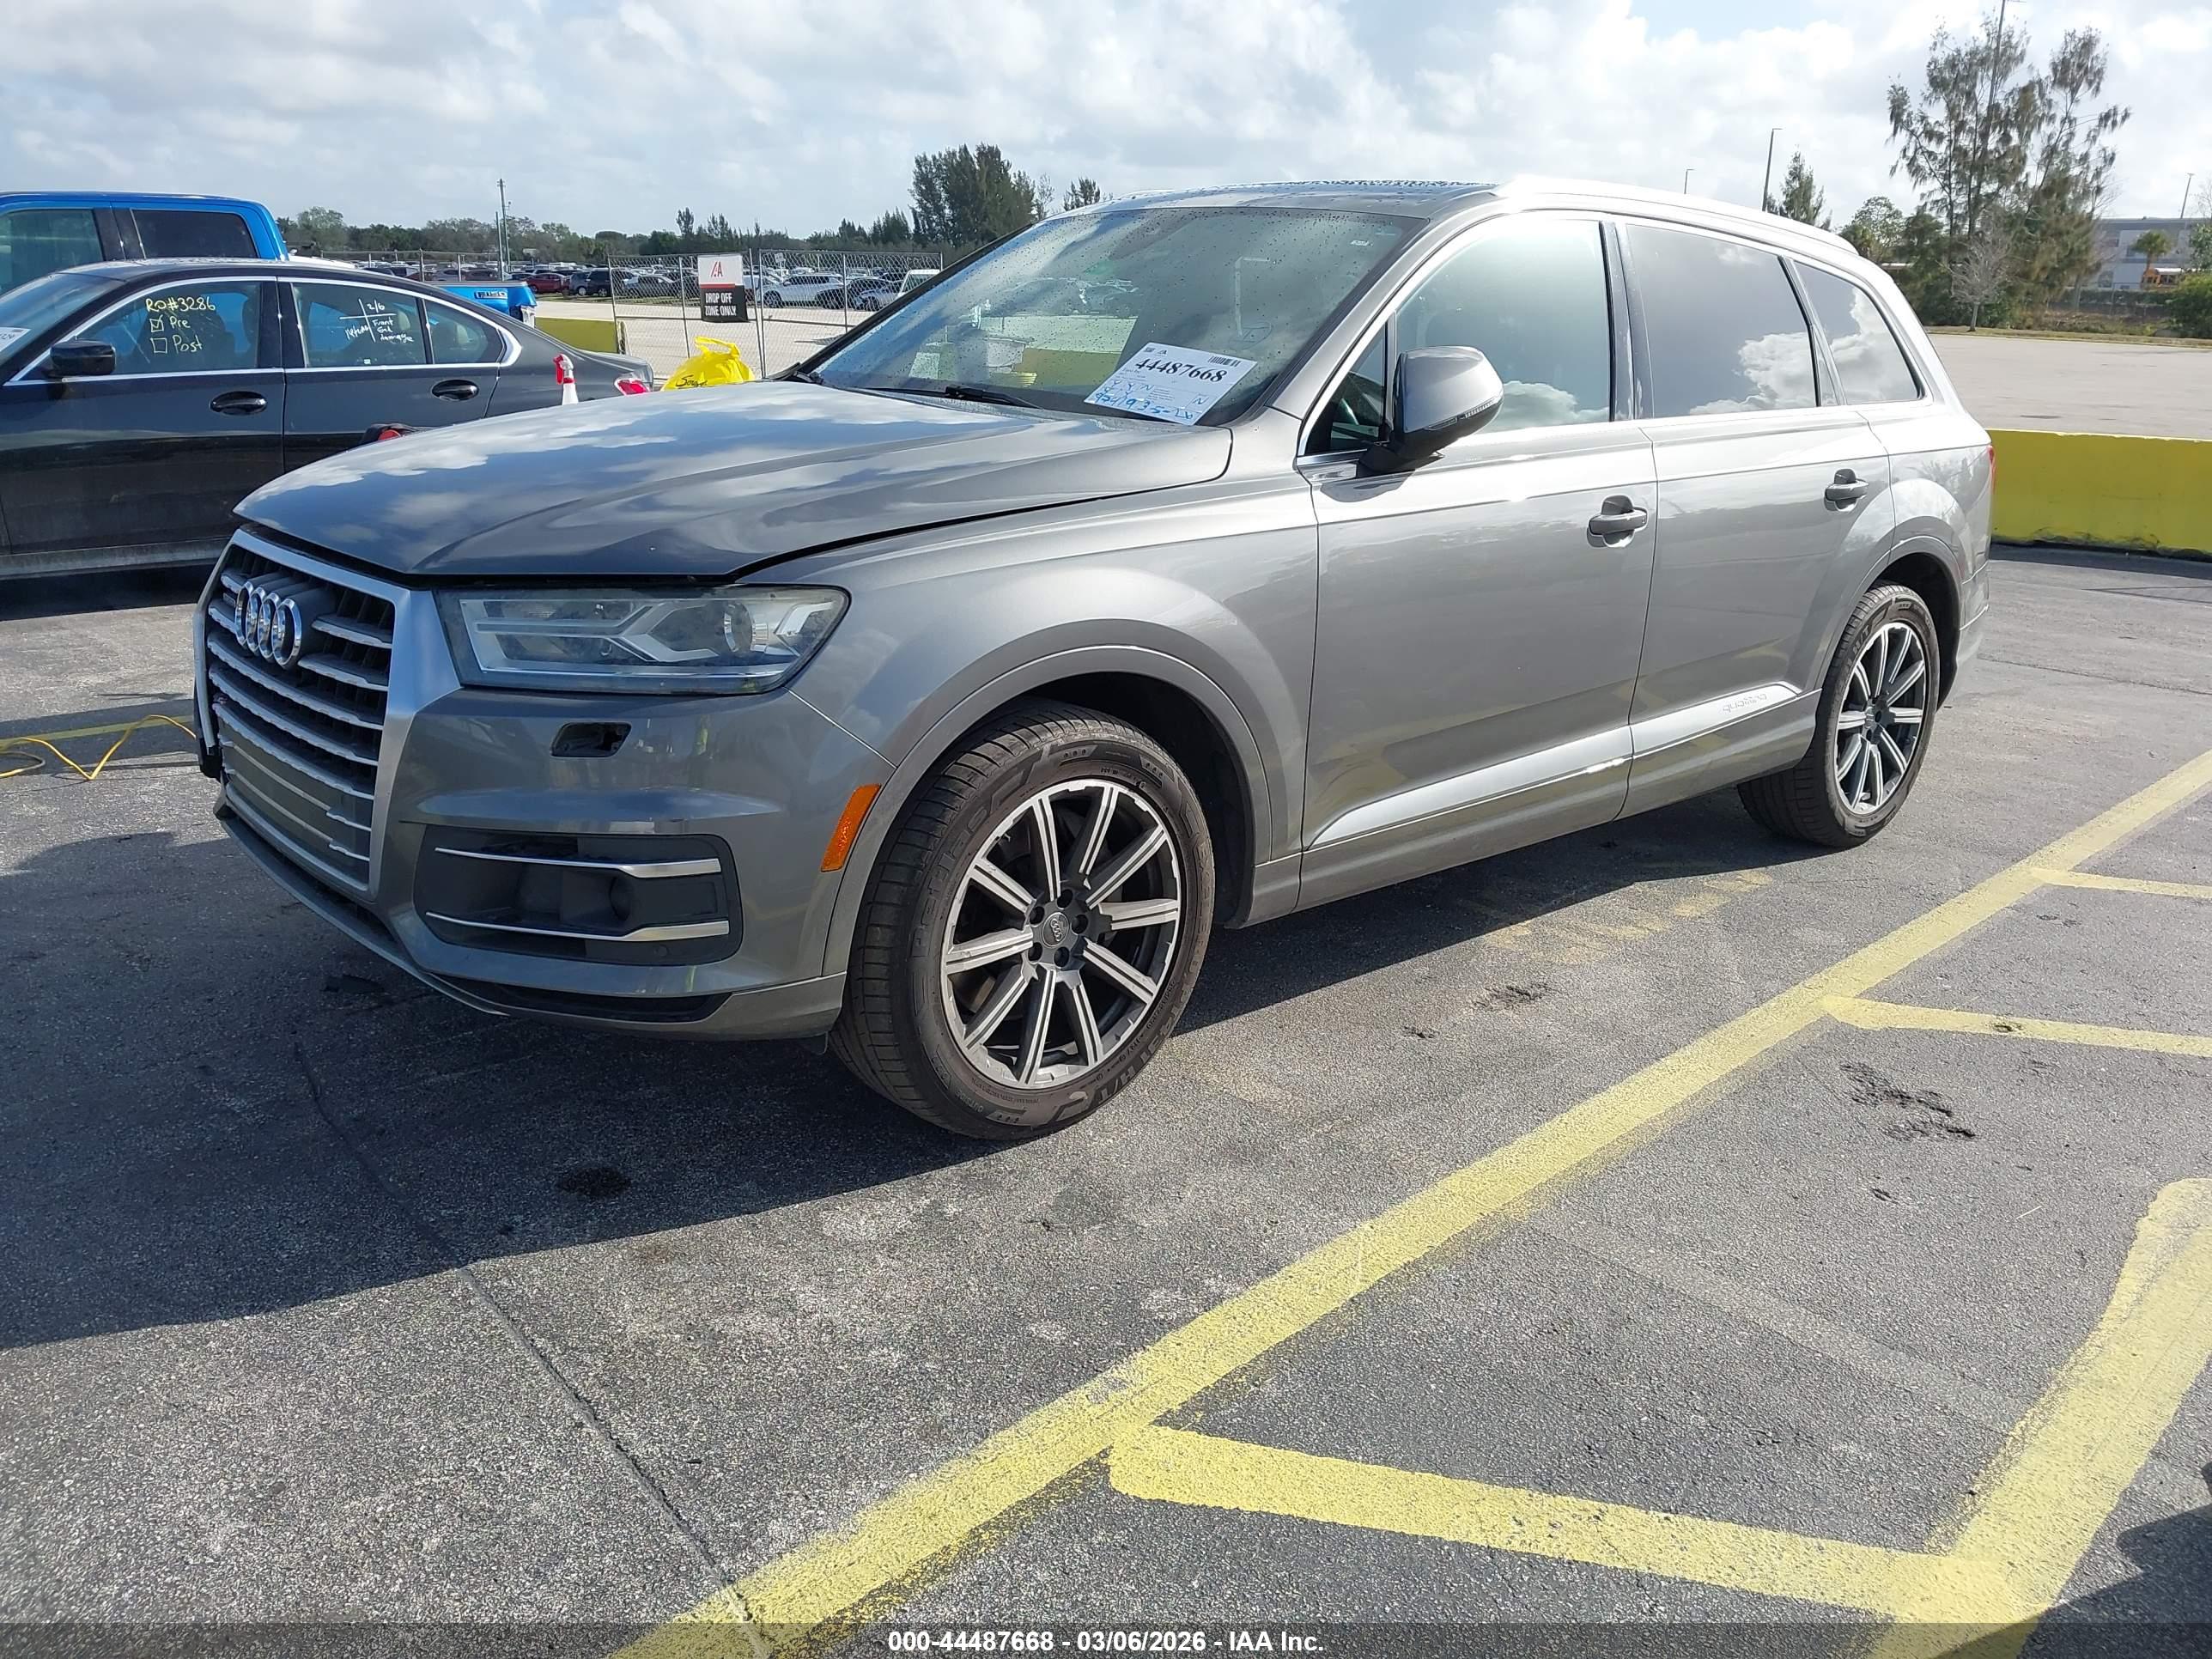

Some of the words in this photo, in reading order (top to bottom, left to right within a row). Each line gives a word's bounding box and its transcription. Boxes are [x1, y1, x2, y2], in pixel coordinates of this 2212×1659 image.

[705, 293, 720, 303] DROP
[720, 293, 732, 303] OFF
[704, 305, 720, 316] ZONE
[720, 305, 737, 316] ONLY
[169, 315, 191, 330] Pre
[172, 334, 204, 354] Post
[1135, 358, 1228, 383] 44487668
